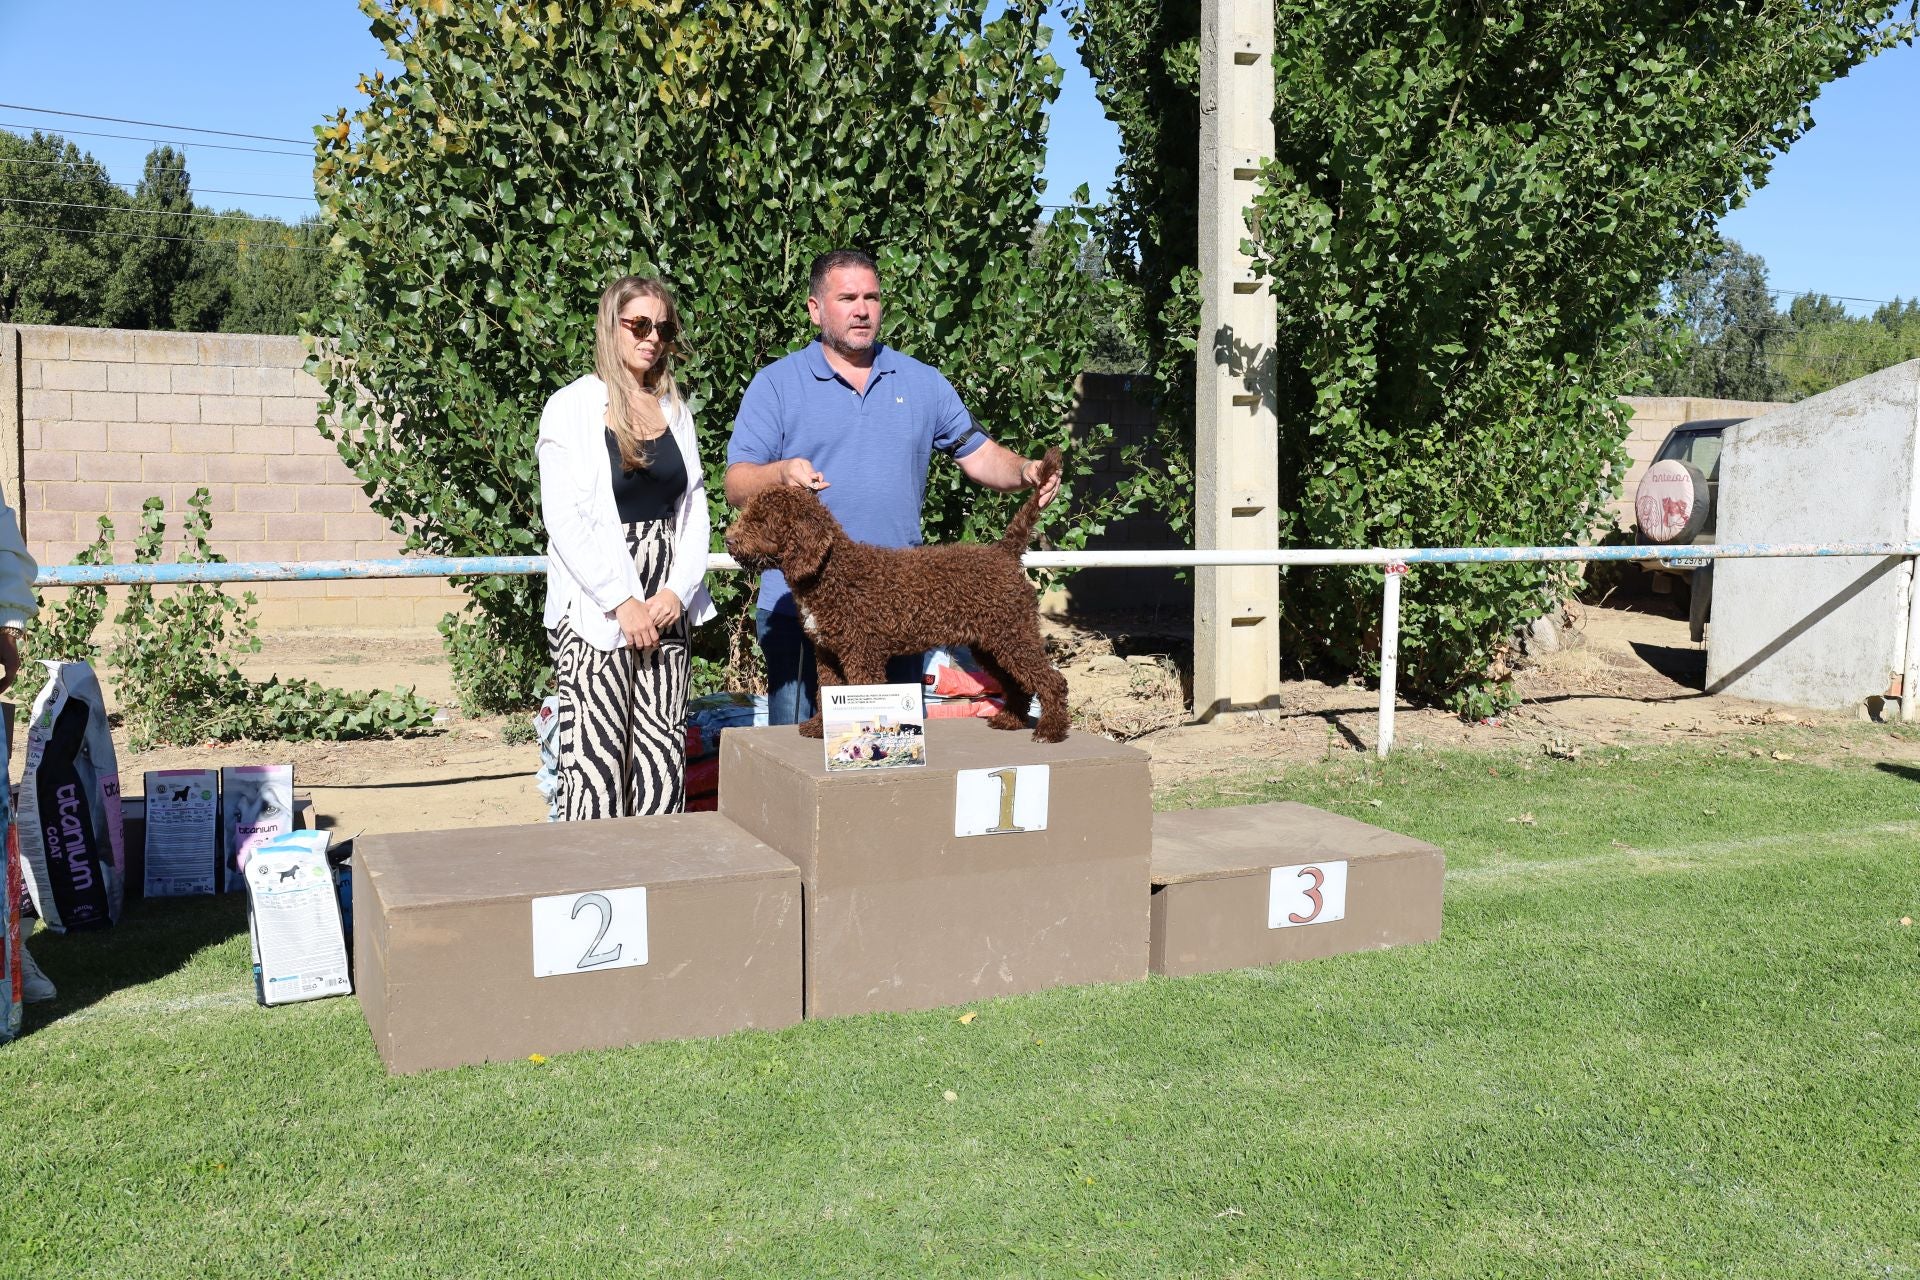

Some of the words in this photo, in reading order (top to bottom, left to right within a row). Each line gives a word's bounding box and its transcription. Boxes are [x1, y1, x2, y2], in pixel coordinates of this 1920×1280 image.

[831, 695, 846, 704] VII
[986, 767, 1025, 833] 1
[46, 826, 63, 859] COAT
[56, 783, 93, 891] titanium
[238, 824, 278, 834] titanium
[1288, 866, 1324, 923] 3
[571, 893, 623, 969] 2
